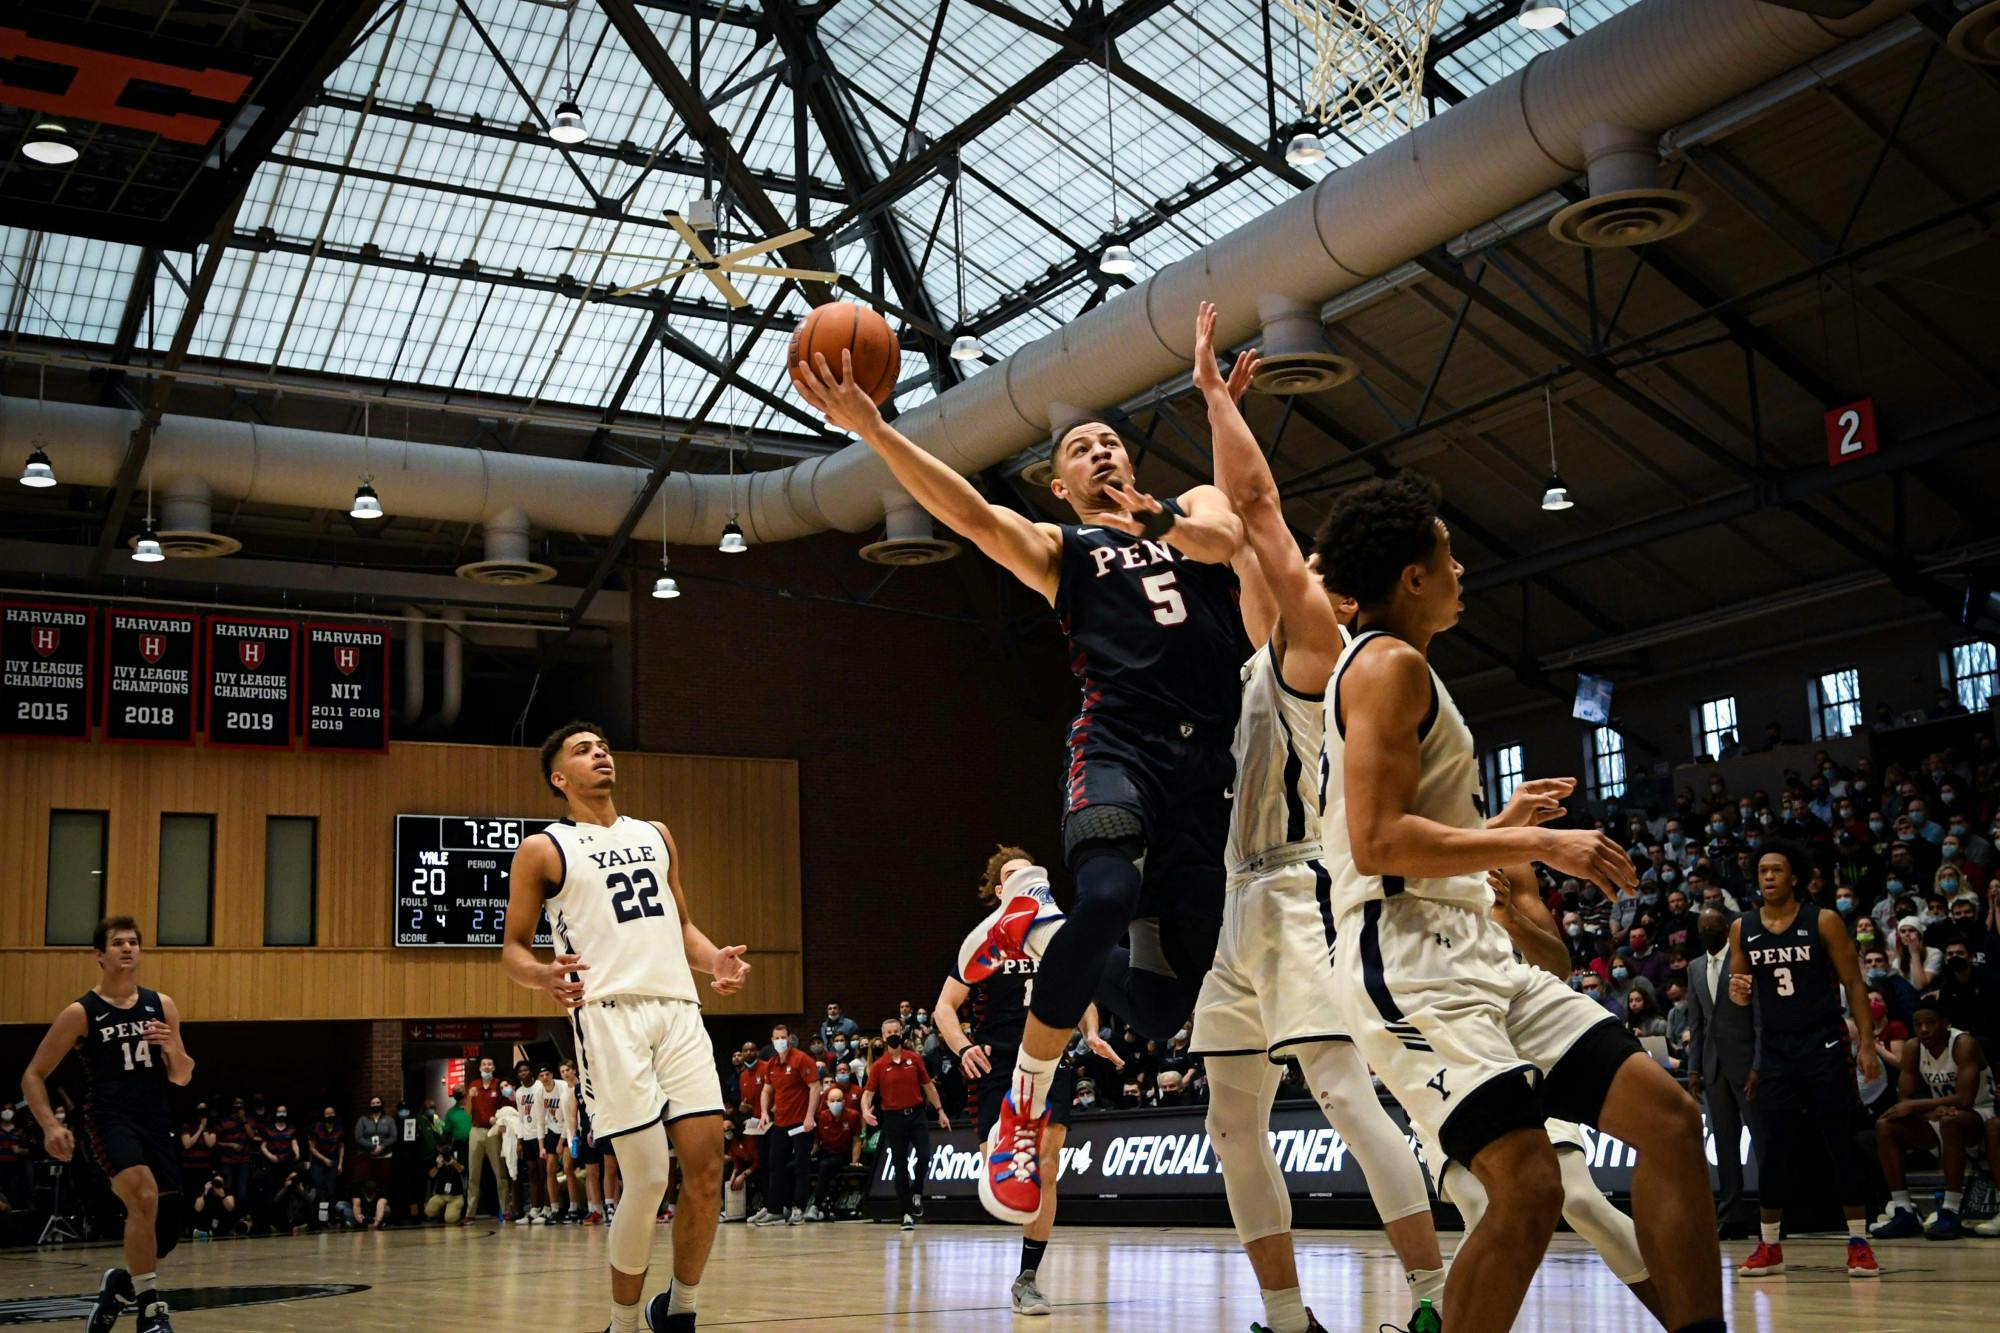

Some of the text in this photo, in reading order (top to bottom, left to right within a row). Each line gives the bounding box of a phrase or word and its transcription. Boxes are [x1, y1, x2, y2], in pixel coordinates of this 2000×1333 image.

[1838, 410, 1863, 455] 2
[1089, 540, 1189, 578] PEN
[1141, 570, 1188, 626] 5
[6, 609, 86, 626] HARVARD
[115, 616, 191, 633] HARVARD
[38, 630, 53, 648] H
[216, 624, 289, 640] HARVARD
[312, 630, 382, 645] HARVARD
[145, 637, 159, 656] H
[245, 644, 258, 662] H
[5, 660, 83, 675] IVY LEAGUE
[340, 650, 353, 668] H
[4, 673, 84, 689] CHAMPIONS
[114, 665, 188, 681] IVY LEAGUE
[215, 672, 287, 688] IVY LEAGUE
[113, 679, 189, 695] CHAMPIONS
[214, 685, 287, 700] CHAMPIONS
[331, 683, 362, 700] NIT
[17, 701, 69, 721] 2015
[125, 706, 174, 725] 2018
[312, 706, 381, 718] 2011 2018
[226, 712, 273, 730] 2019
[311, 719, 343, 731] 2019
[464, 821, 519, 848] 7:26
[419, 851, 449, 866] YALE
[467, 860, 496, 869] PERIOD
[589, 846, 656, 869] YALE
[412, 868, 446, 895] 20
[401, 898, 428, 907] FOULS
[456, 898, 487, 907] PLAYER
[606, 868, 665, 924] 22
[411, 909, 446, 929] 2 4
[401, 933, 427, 942] SCORE
[467, 934, 496, 943] MATCH
[535, 934, 553, 943] SCO
[1749, 945, 1811, 966] PENN
[1773, 967, 1795, 996] 3
[121, 1040, 153, 1071] 14
[1427, 1069, 1451, 1101] Y
[1924, 1072, 1957, 1083] YALE
[1102, 1134, 1211, 1176] OFFICIAL
